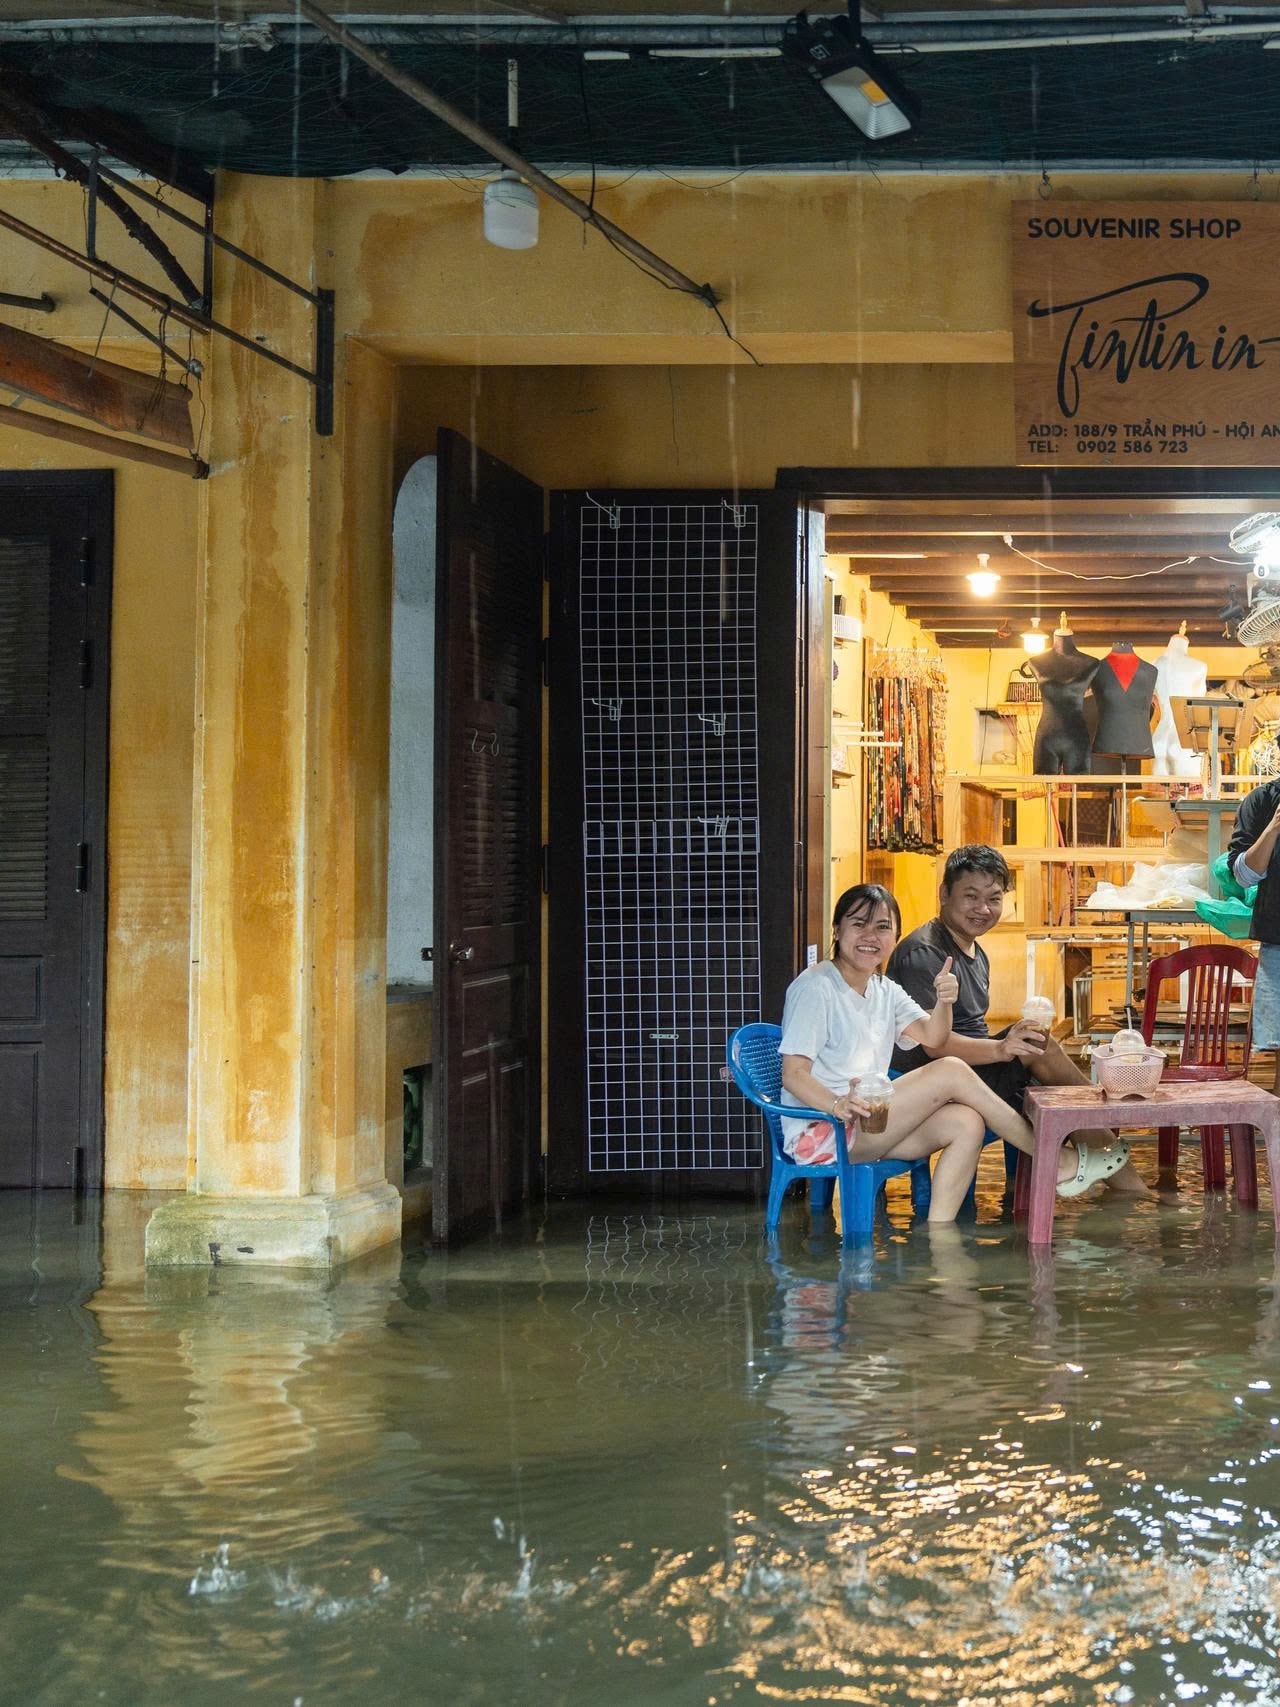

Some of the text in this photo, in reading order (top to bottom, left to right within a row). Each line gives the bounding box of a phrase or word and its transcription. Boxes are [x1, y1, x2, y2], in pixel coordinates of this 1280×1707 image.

[1027, 217, 1241, 240] SOUVENIR SHOP
[1211, 325, 1266, 371] in
[1027, 424, 1068, 438] ADD:
[1074, 423, 1118, 439] 188/9
[1172, 420, 1207, 438] PHÚ
[1225, 421, 1255, 440] HỘI
[1027, 440, 1188, 454] TEL: 0902 586 723
